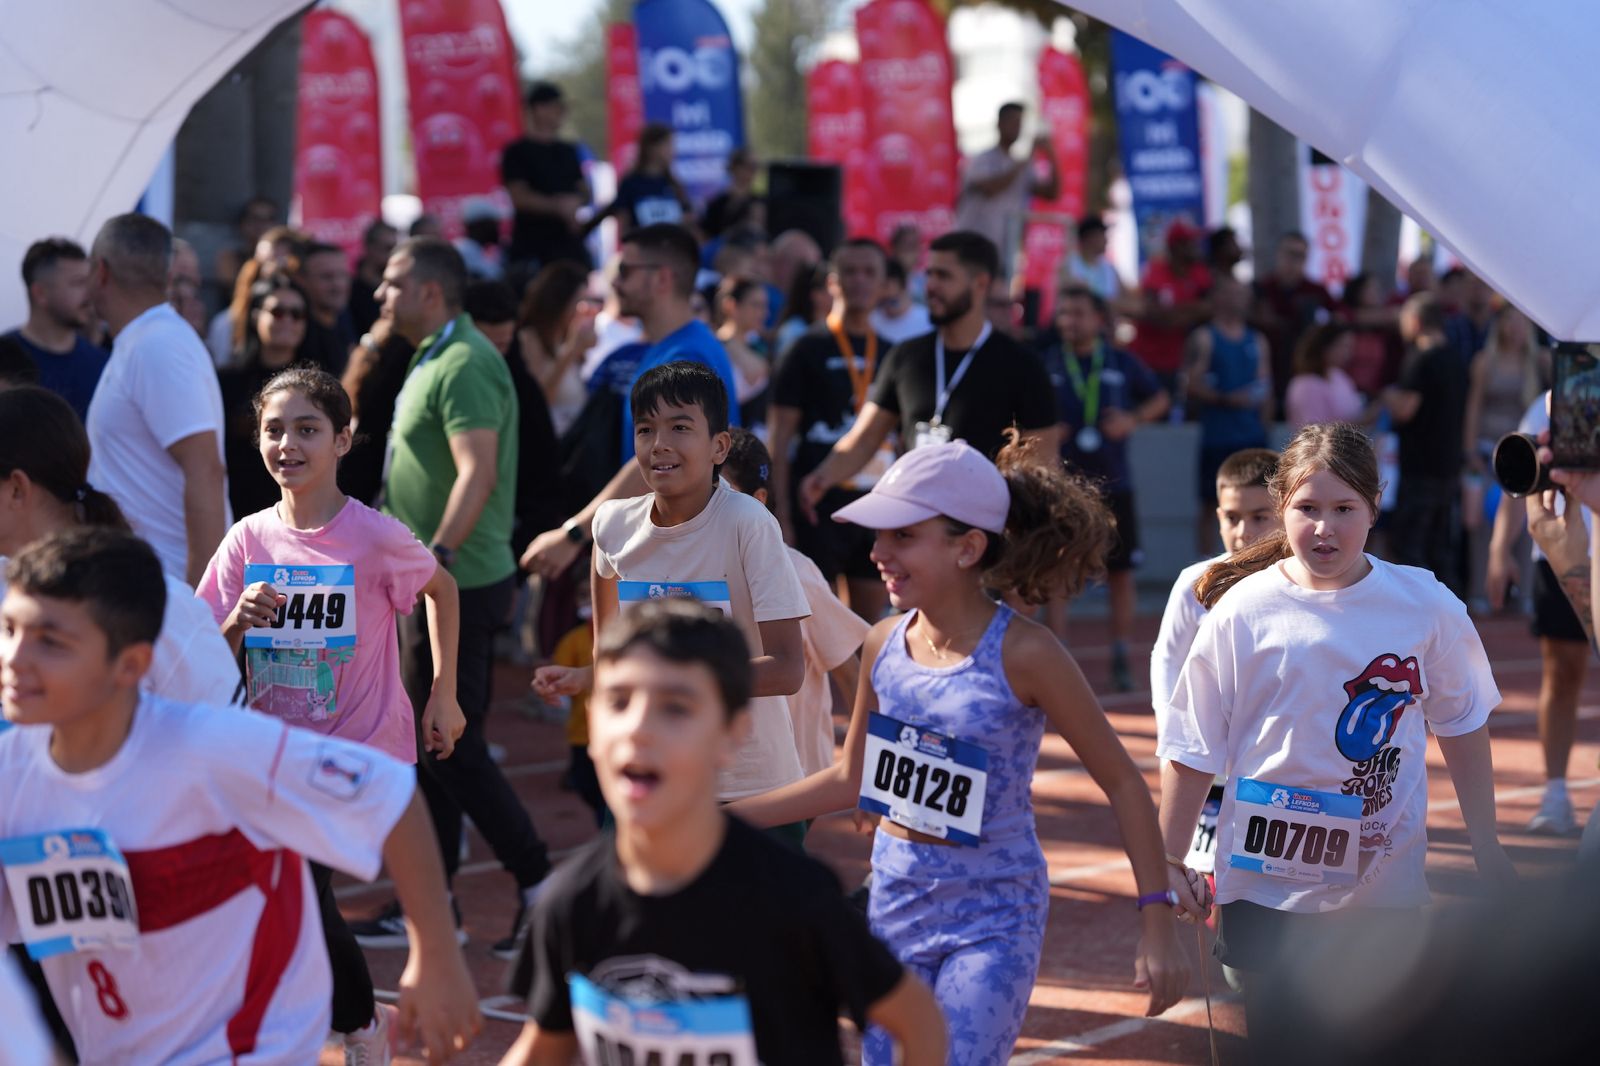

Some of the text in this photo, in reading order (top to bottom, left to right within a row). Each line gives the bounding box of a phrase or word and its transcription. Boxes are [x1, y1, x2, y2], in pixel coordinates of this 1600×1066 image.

[253, 593, 346, 630] 0449
[874, 748, 973, 819] 08128
[1244, 815, 1350, 868] 00709
[86, 959, 129, 1021] 8
